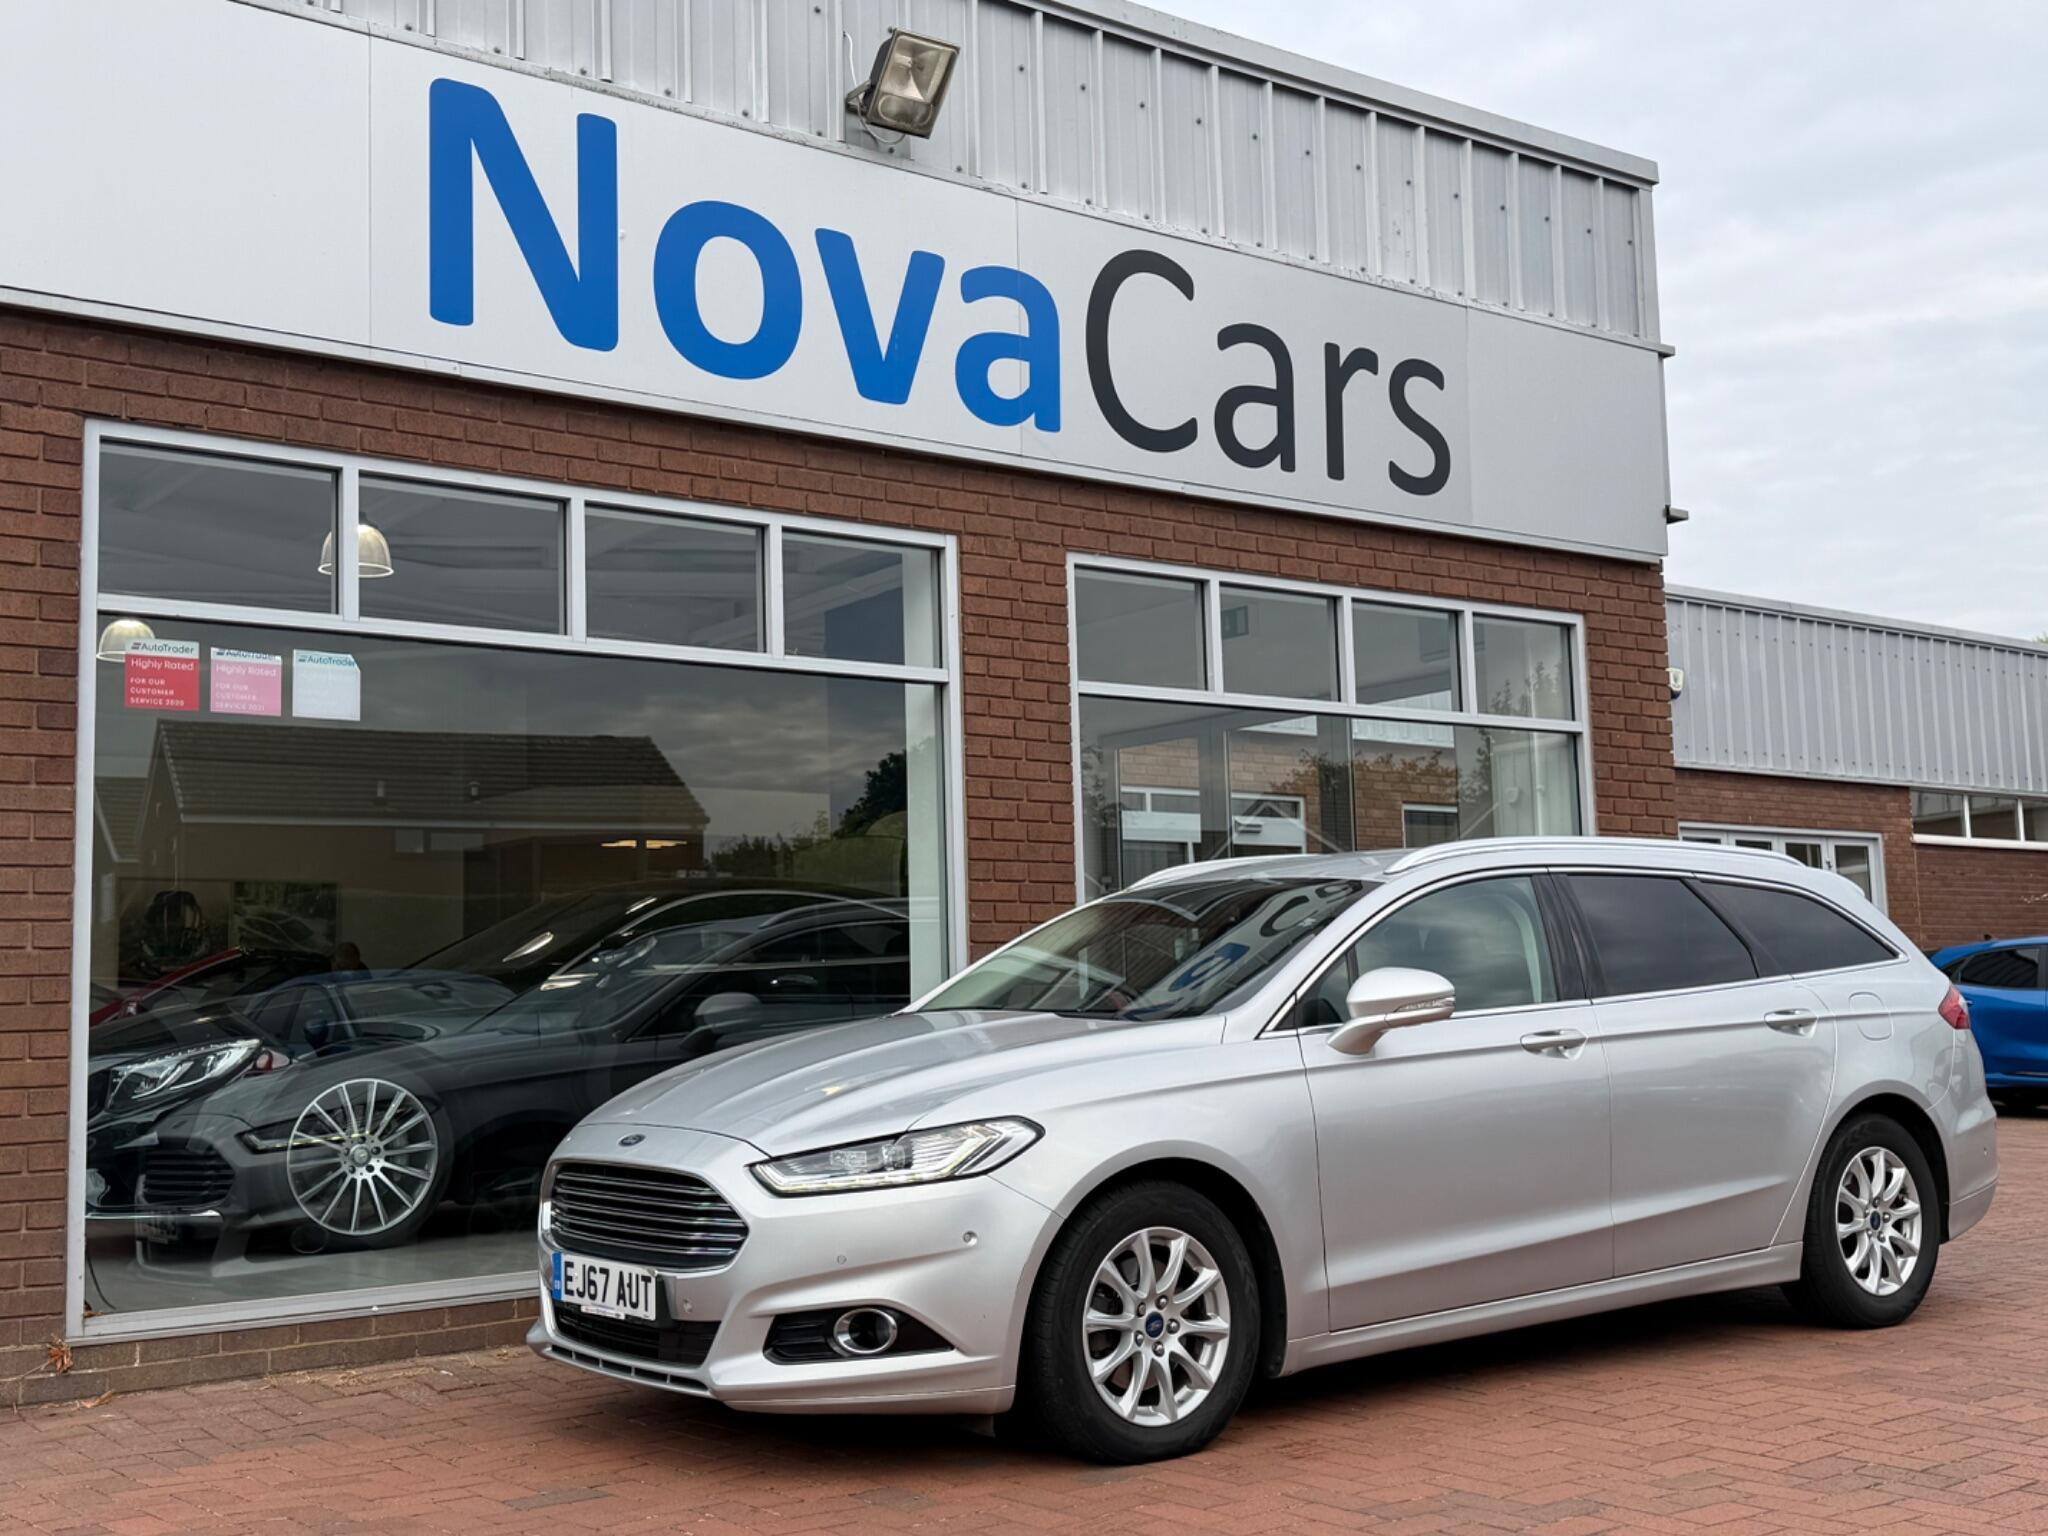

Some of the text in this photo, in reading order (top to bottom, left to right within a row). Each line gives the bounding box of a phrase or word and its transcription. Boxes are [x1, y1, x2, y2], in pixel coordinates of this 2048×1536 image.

[141, 643, 195, 654] AutoTrader
[131, 658, 194, 671] Highly Rated
[216, 663, 276, 677] Highly Rated
[148, 678, 166, 686] OUR
[130, 687, 174, 696] CUSTOMER
[130, 697, 164, 705] SERVICE
[564, 1261, 652, 1312] EJ67 AUT
